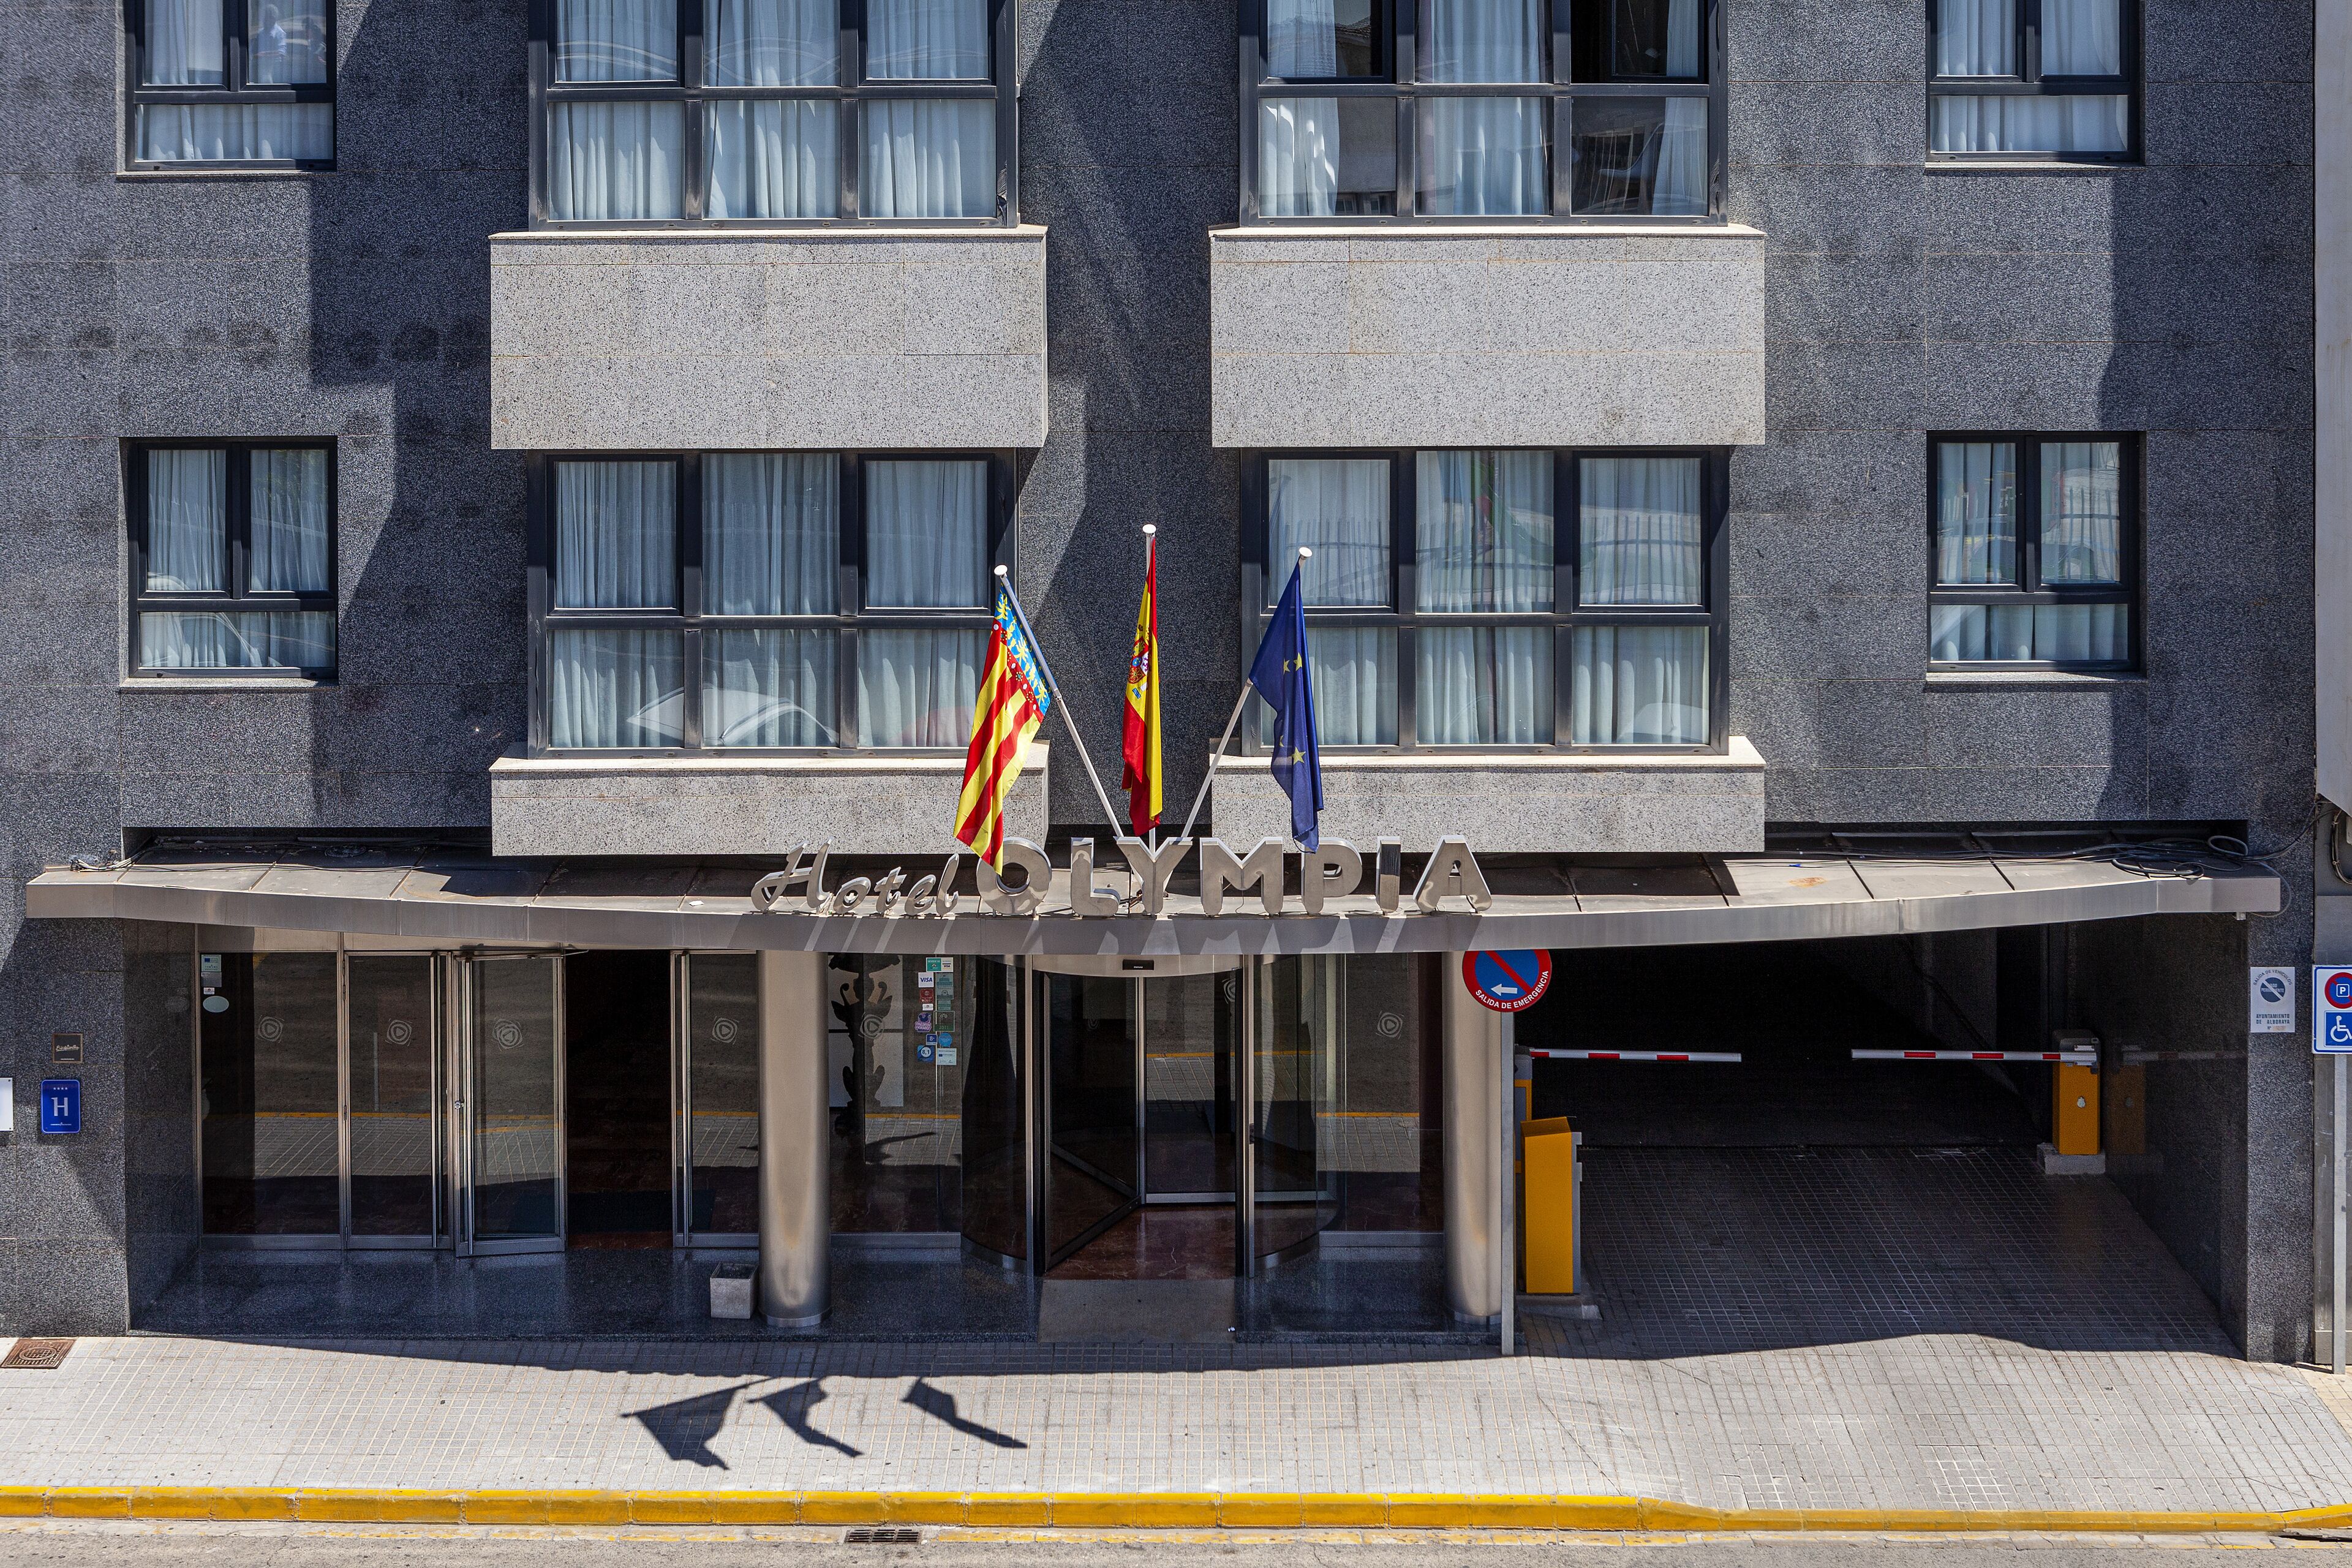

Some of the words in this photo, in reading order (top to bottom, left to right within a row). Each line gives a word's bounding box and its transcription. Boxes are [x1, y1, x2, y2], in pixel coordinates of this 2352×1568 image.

[750, 835, 960, 916] Hotel
[976, 835, 1492, 916] OLYMPIA
[2253, 972, 2265, 986] SALIDA
[1476, 989, 1499, 1008] SALIDA
[1513, 971, 1549, 1008] EMERGENCIA
[2340, 986, 2346, 995] P
[51, 1097, 68, 1117] H
